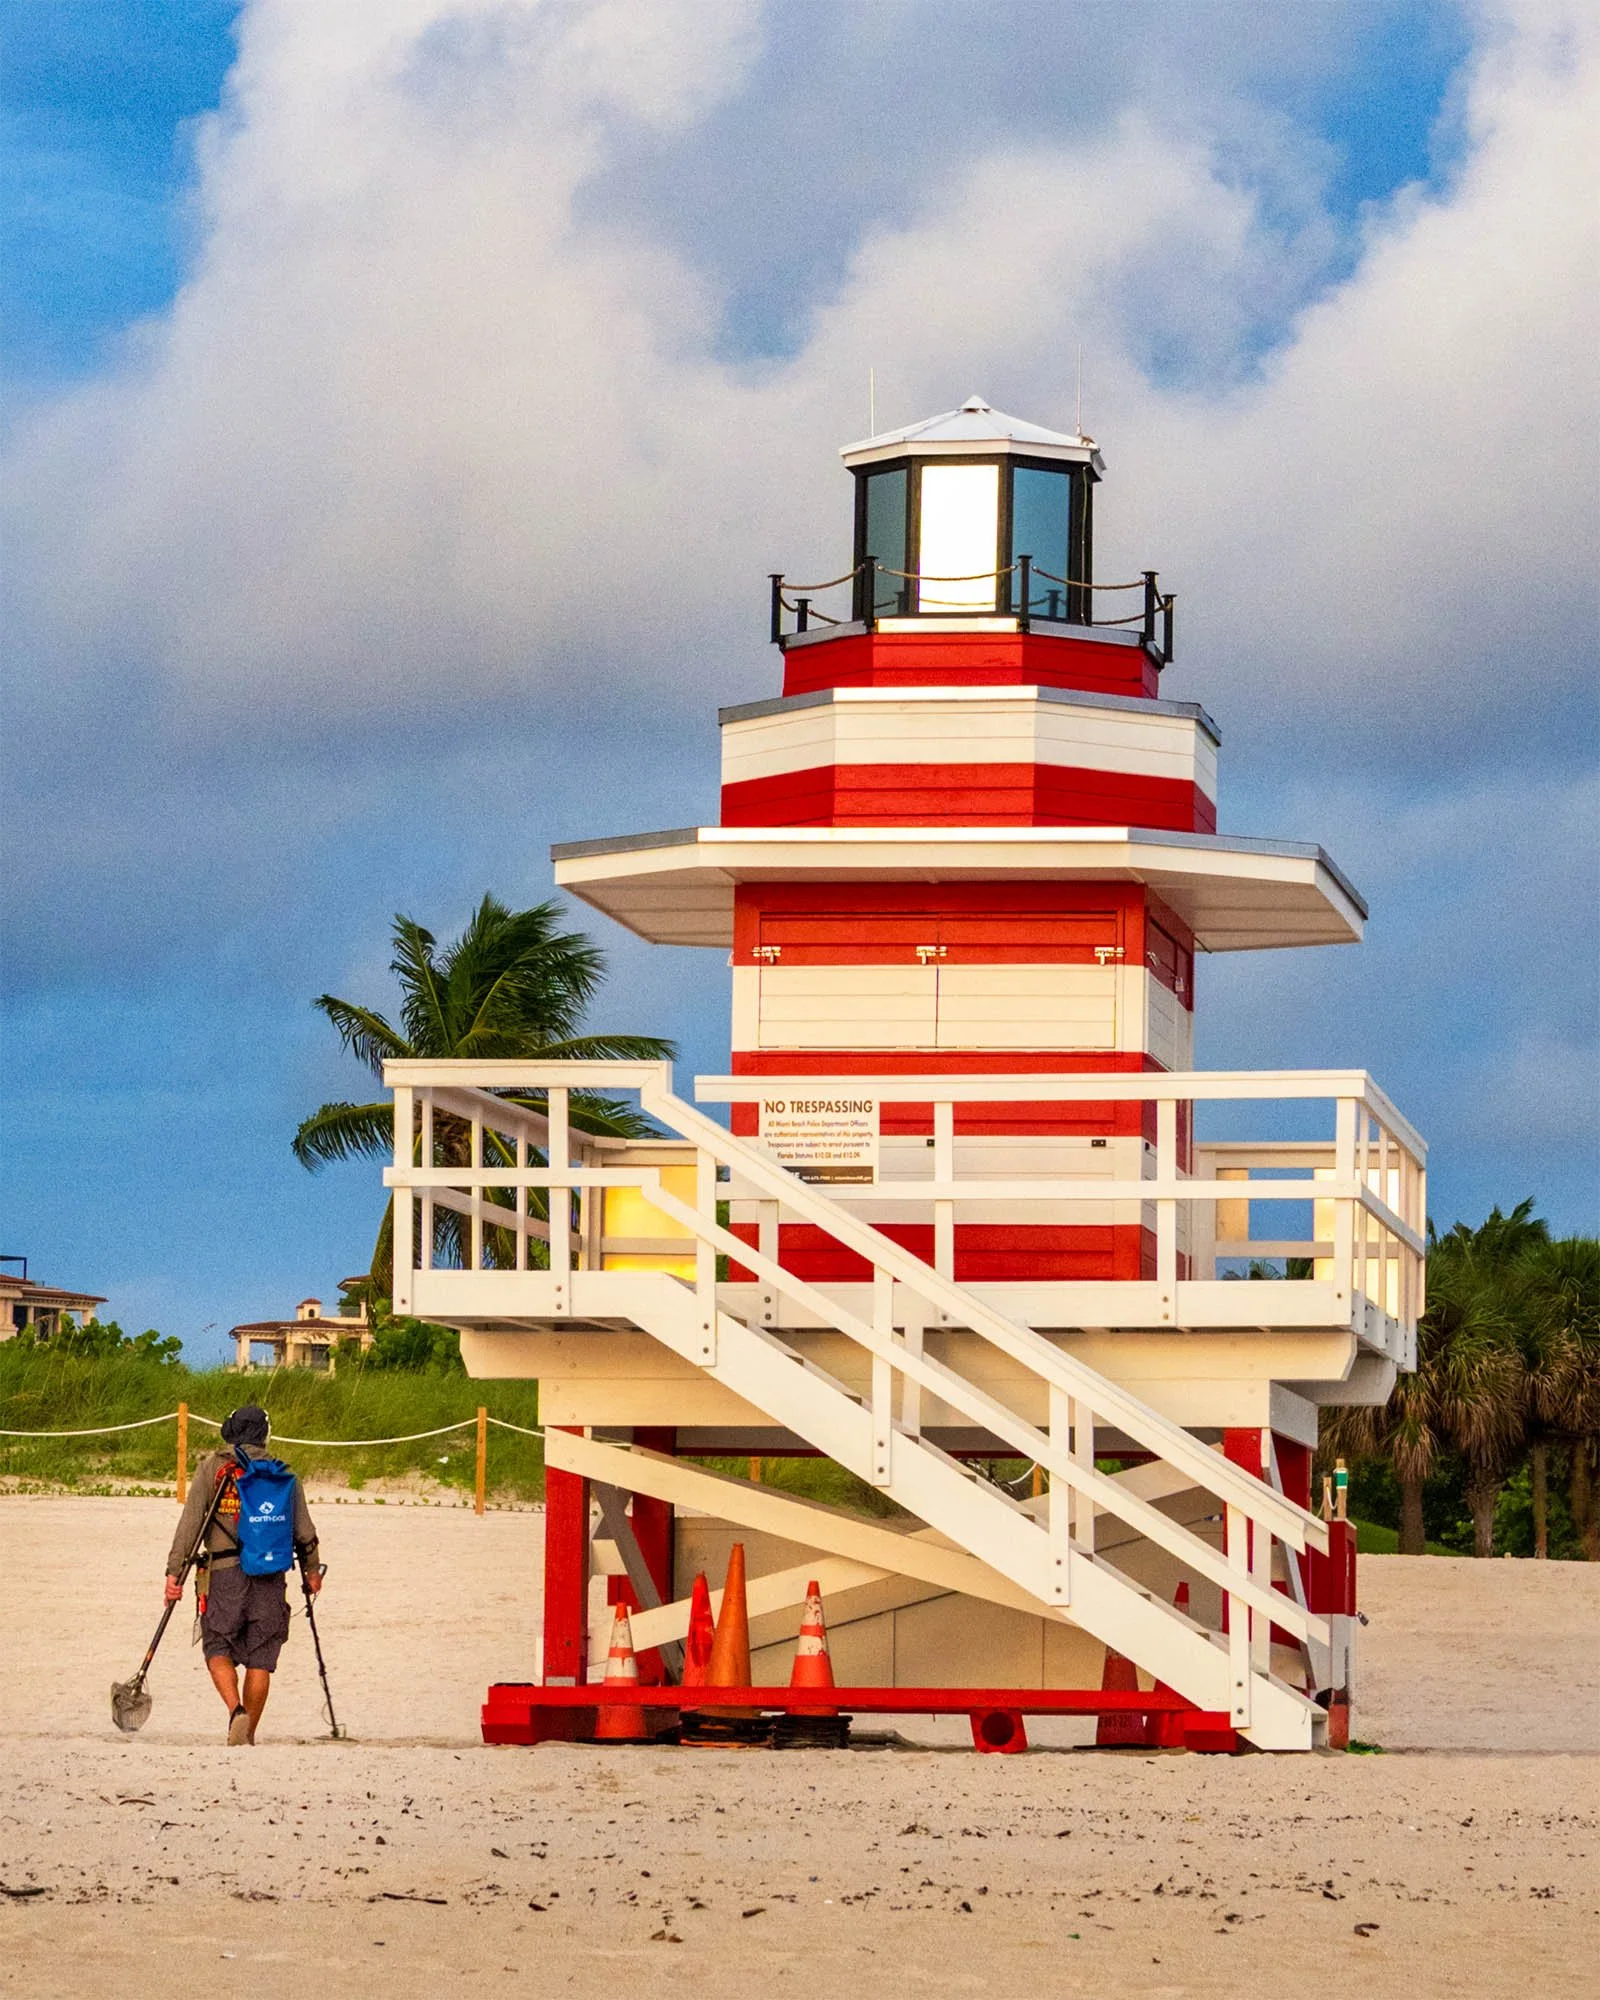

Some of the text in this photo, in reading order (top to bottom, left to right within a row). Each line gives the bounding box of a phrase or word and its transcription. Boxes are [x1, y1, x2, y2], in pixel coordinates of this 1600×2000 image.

[765, 1101, 873, 1113] NO TRESPASSING
[768, 1141, 794, 1149] Trespassers
[805, 1141, 821, 1149] subject
[777, 1151, 794, 1159] Florida
[795, 1151, 813, 1159] Statutes
